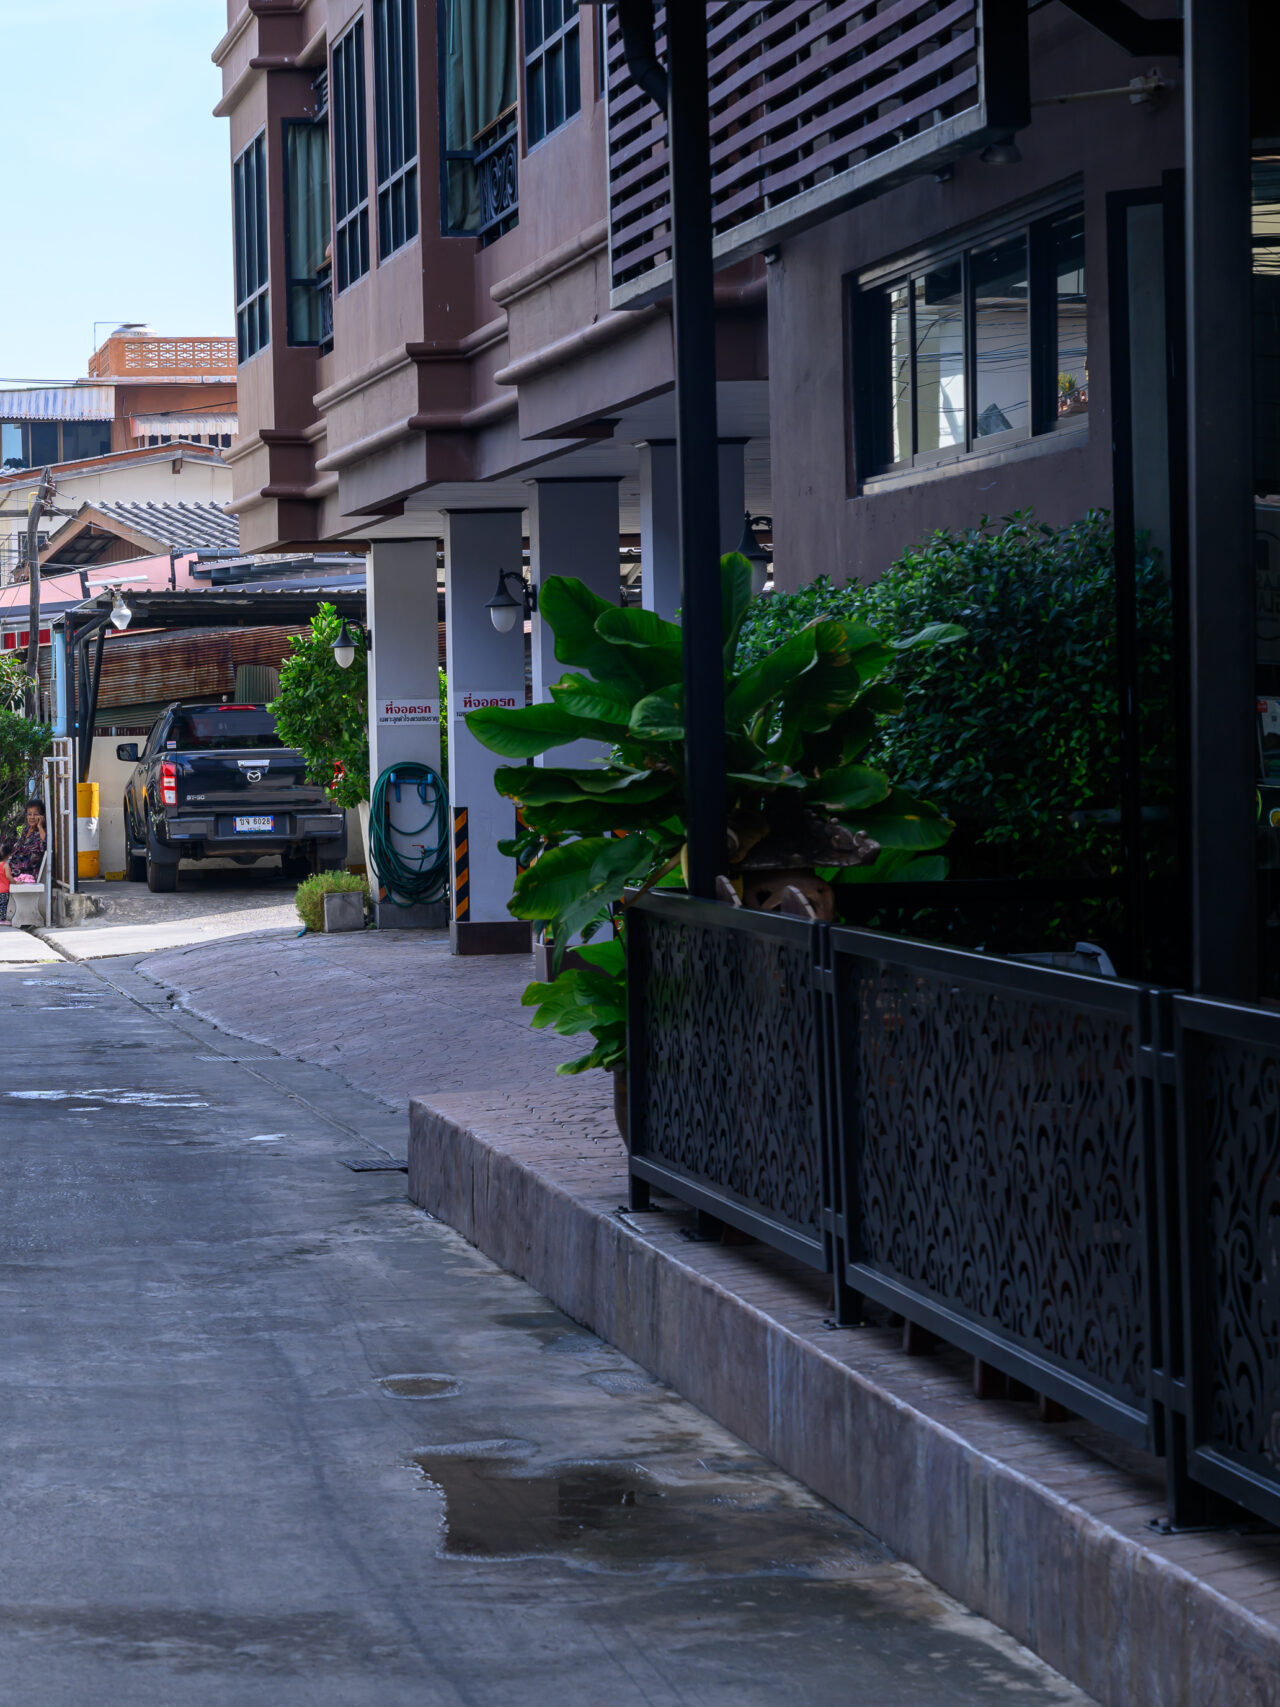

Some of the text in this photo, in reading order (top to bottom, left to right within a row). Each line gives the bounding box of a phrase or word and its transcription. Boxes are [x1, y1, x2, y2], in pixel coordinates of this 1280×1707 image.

[385, 701, 431, 714] ที่จอดรถ
[463, 693, 516, 708] ที่จอดรถ
